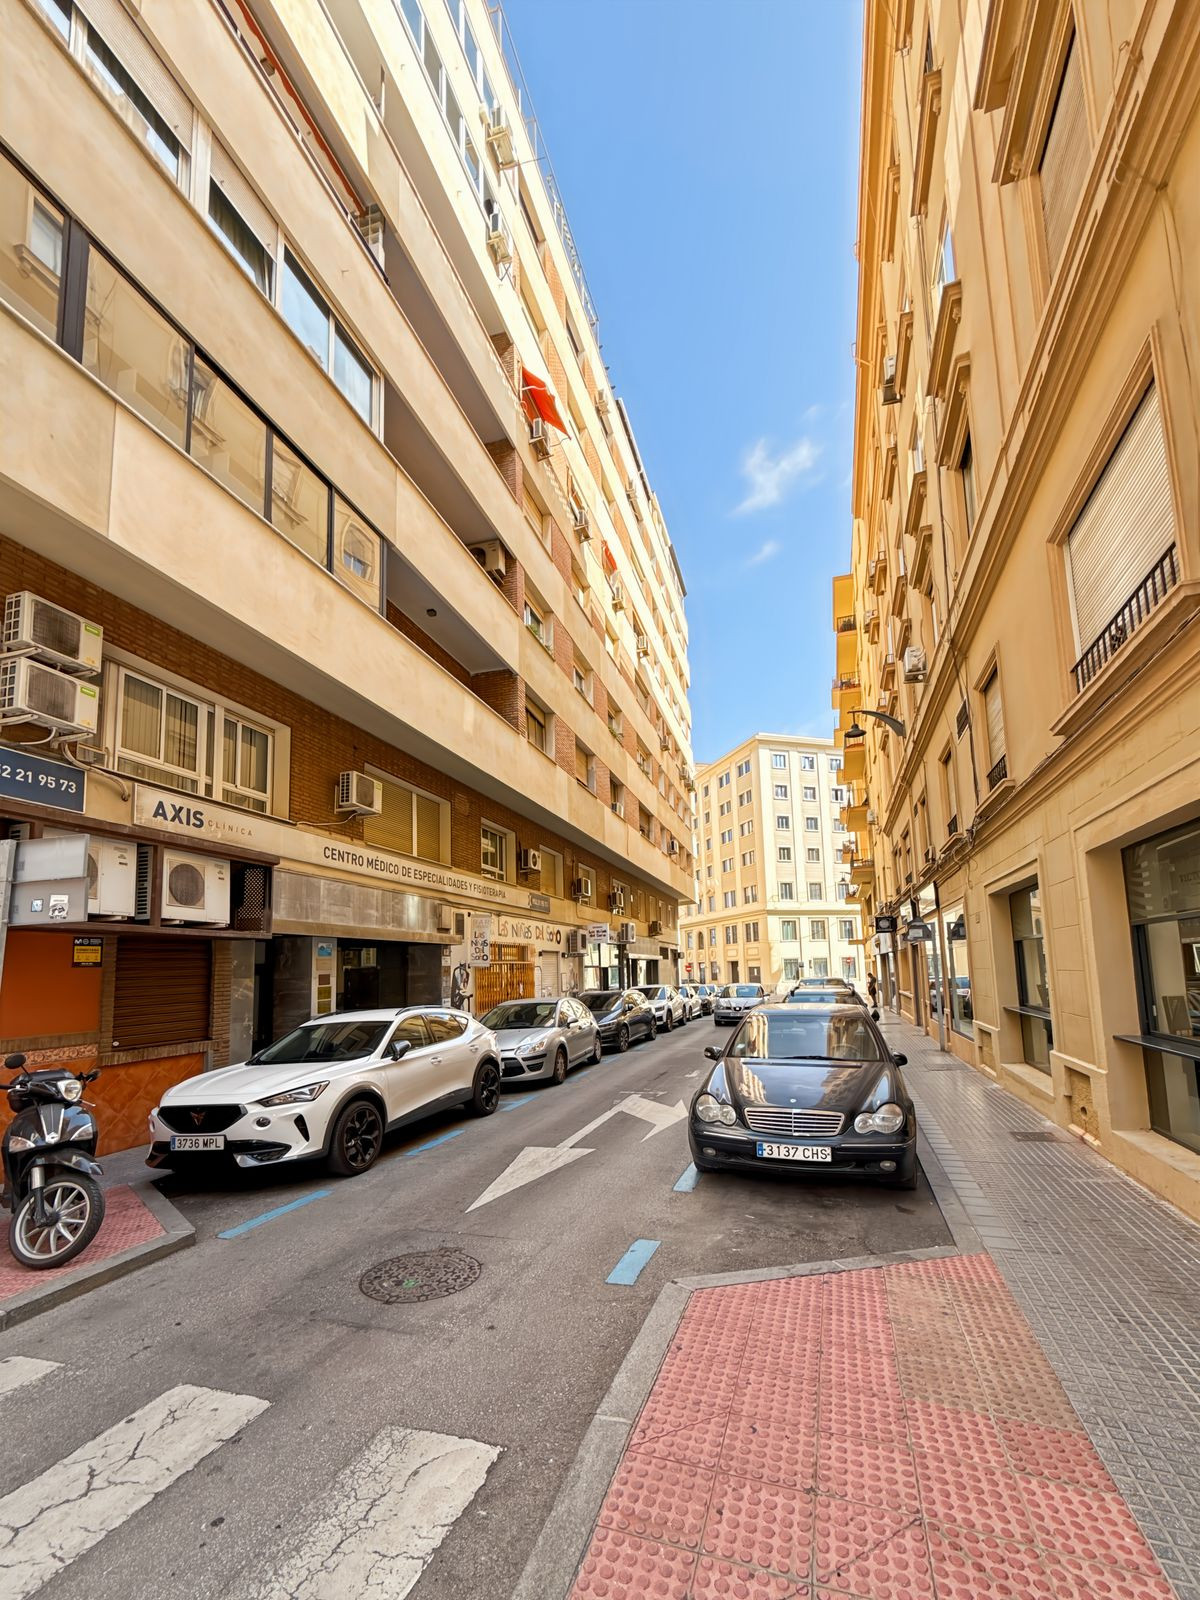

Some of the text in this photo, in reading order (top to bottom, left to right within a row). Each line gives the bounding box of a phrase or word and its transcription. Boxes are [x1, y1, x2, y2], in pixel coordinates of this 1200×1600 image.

[0, 764, 76, 793] 2 21 95 73
[152, 800, 204, 829] AXIS
[323, 846, 364, 867] CENTRO
[366, 856, 399, 875] MÉDICO
[401, 866, 412, 878] DE
[413, 869, 468, 890] ESPECIALIDADES
[468, 882, 473, 891] Y
[176, 1137, 221, 1149] 3736 MPL
[766, 1145, 828, 1160] 3137 CHS
